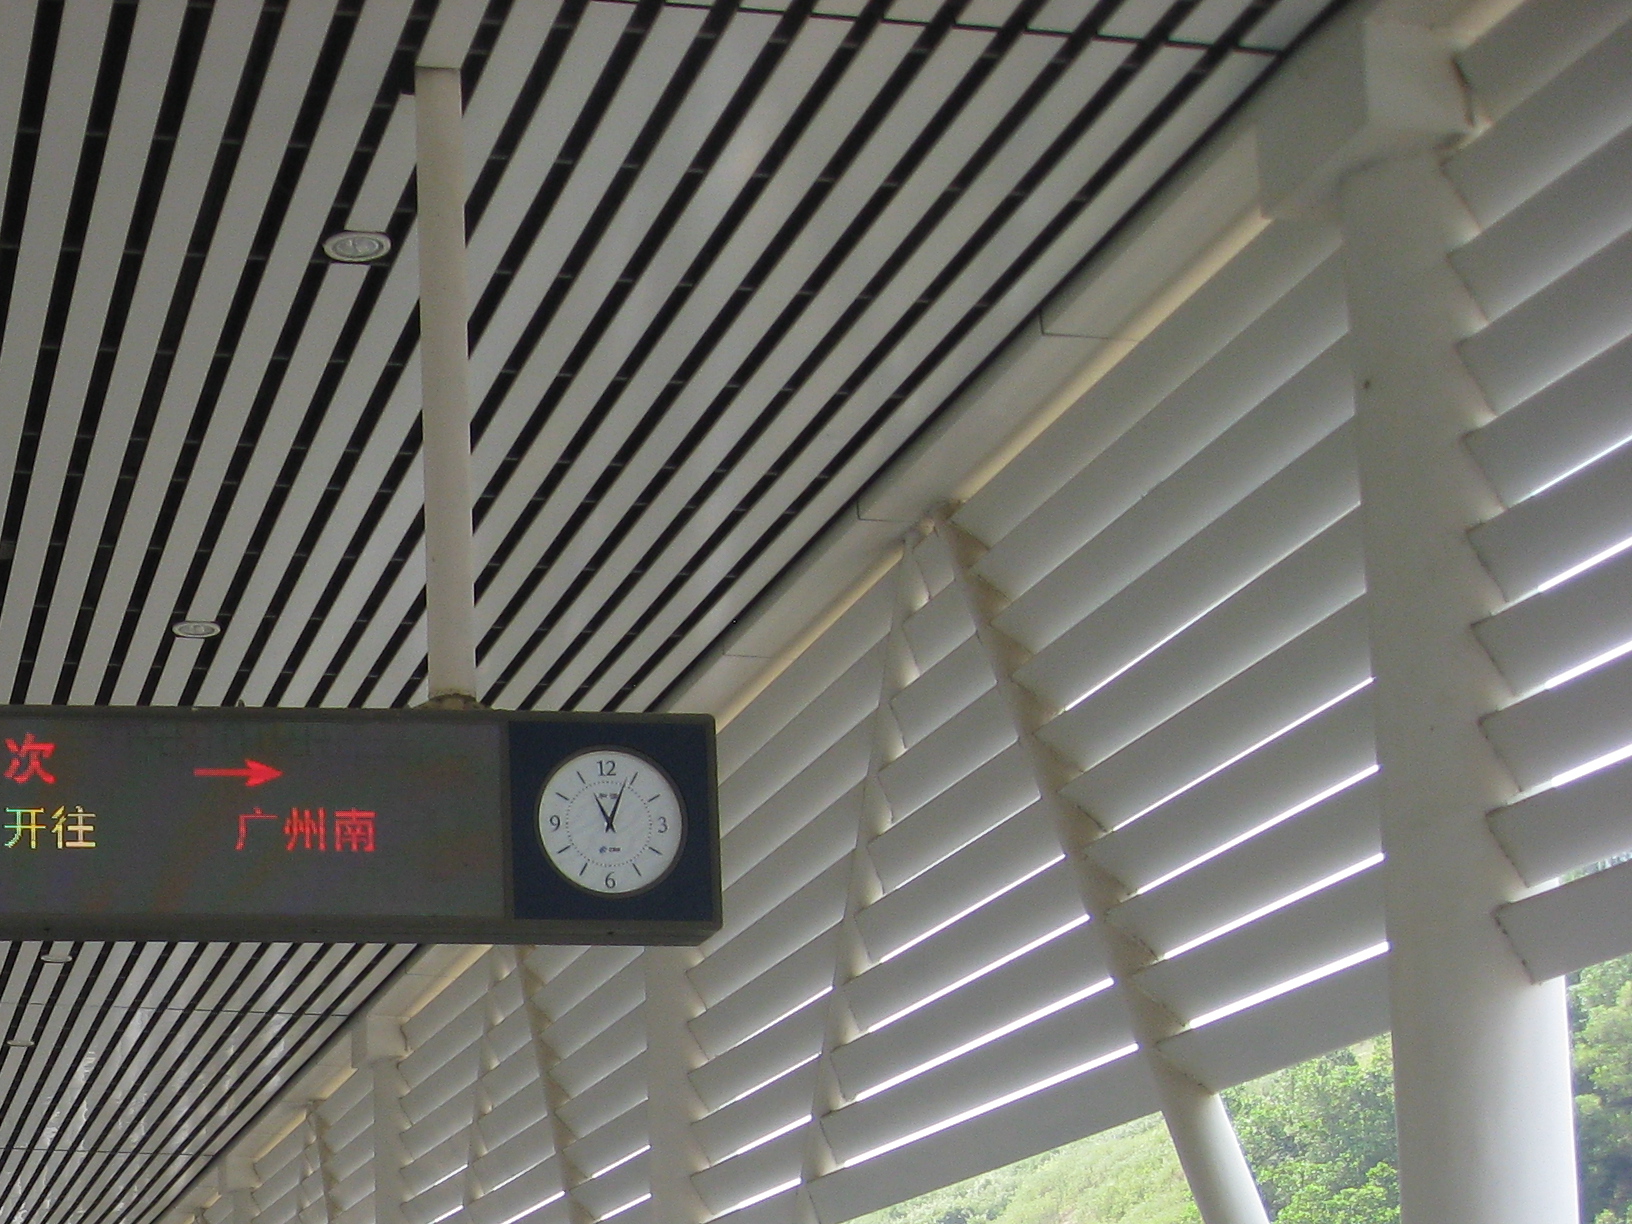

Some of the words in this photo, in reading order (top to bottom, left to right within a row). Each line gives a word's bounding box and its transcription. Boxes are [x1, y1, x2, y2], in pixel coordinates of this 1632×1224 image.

[4, 732, 56, 784] 次
[596, 760, 617, 777] 12
[4, 805, 96, 849] 开往
[234, 806, 376, 852] 广州南
[549, 814, 561, 832] 9
[657, 816, 668, 833] 3
[604, 872, 616, 889] 6
